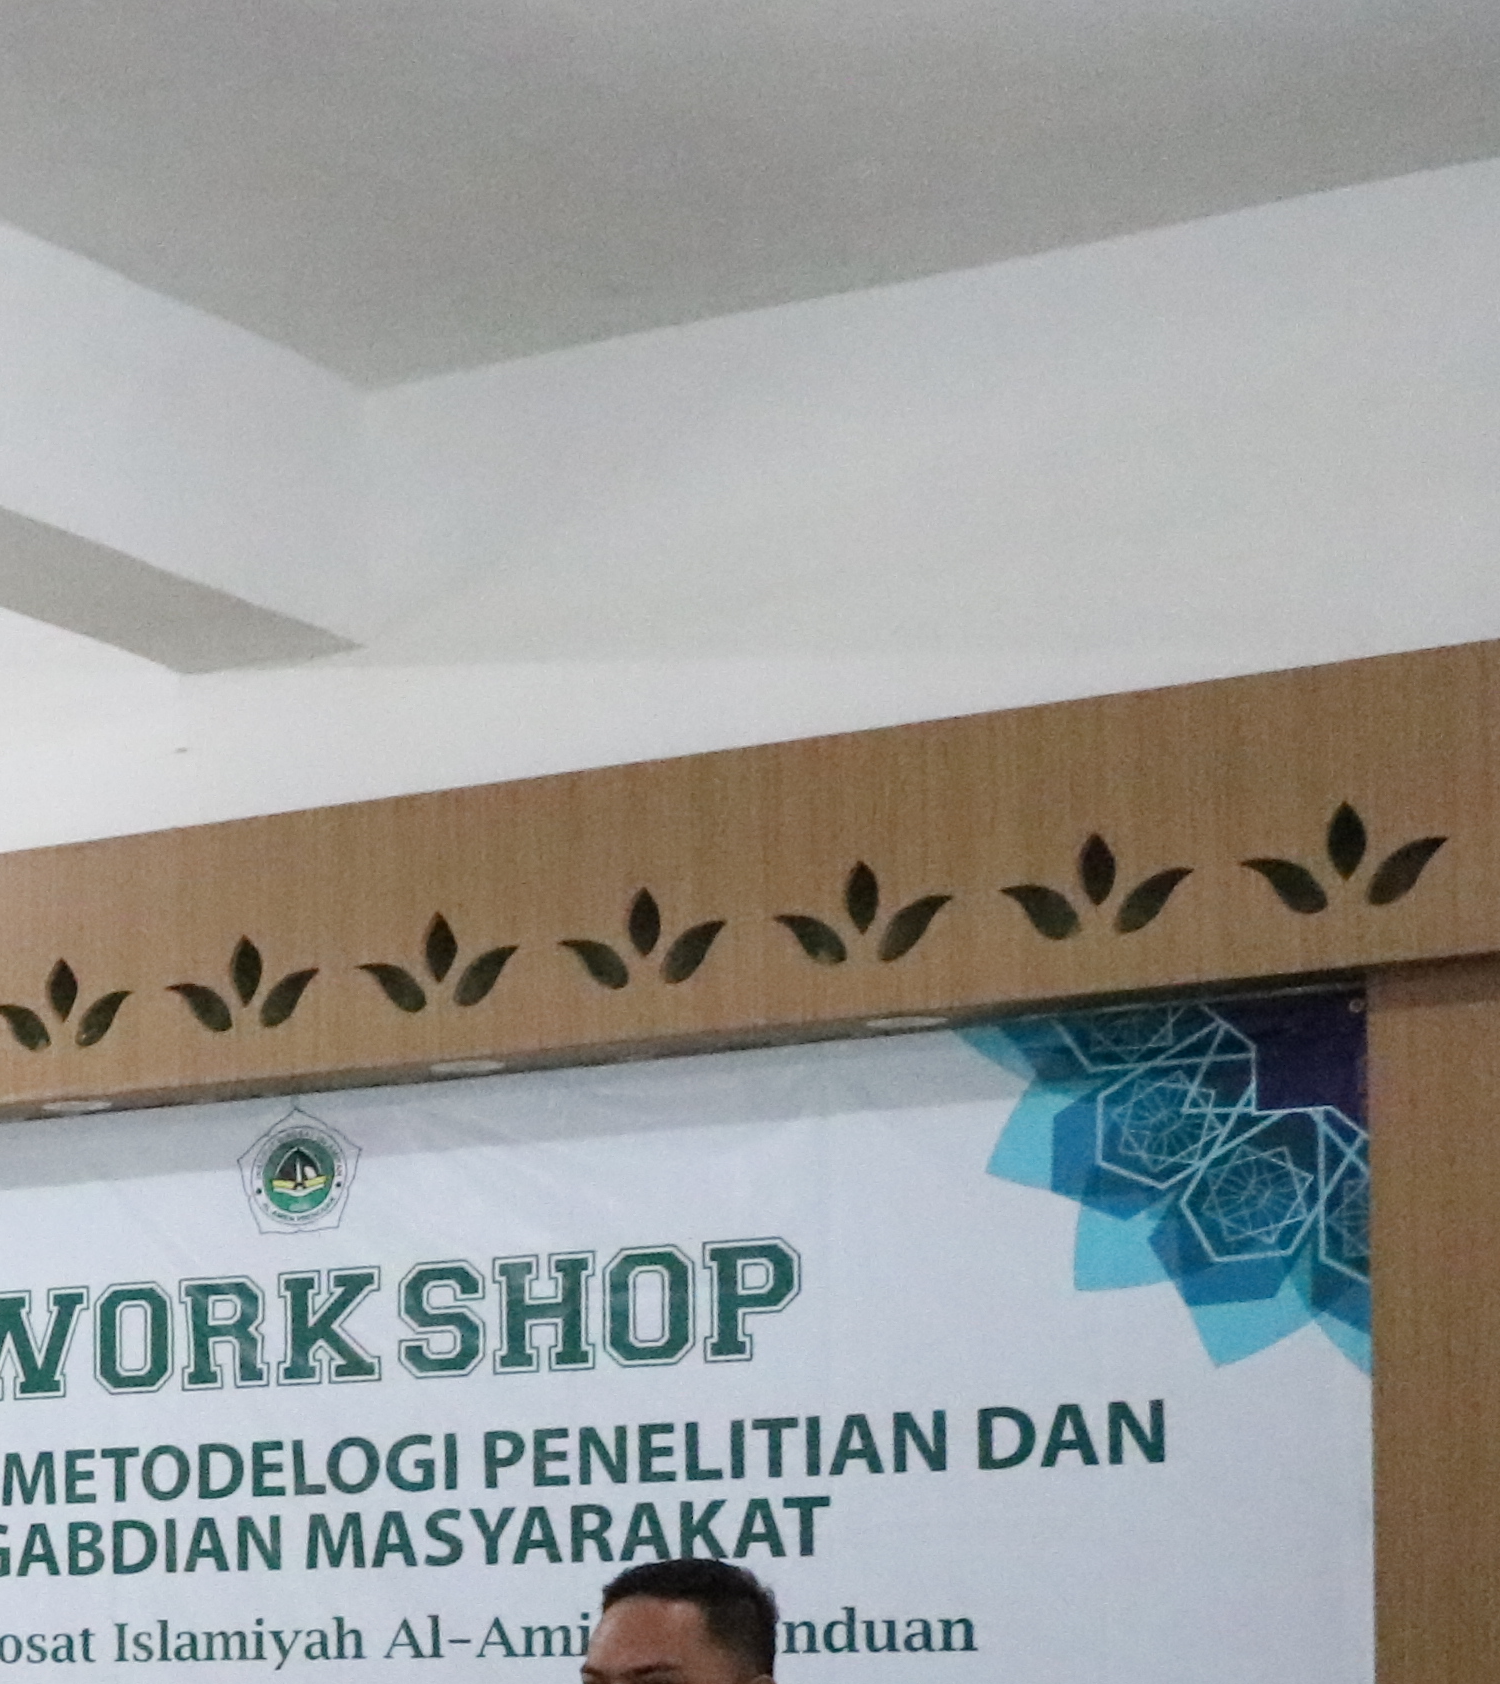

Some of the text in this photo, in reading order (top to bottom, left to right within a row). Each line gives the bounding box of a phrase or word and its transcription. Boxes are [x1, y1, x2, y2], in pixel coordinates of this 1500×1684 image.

[1, 1432, 459, 1507] METODELOGI
[483, 1409, 948, 1490] PENELITIAN
[977, 1398, 1167, 1471] DAN
[305, 1494, 832, 1571] MASYARAKAT
[113, 1615, 368, 1671] Islamiyah
[383, 1612, 592, 1659] Al-Ami
[782, 1605, 979, 1655] nduan
